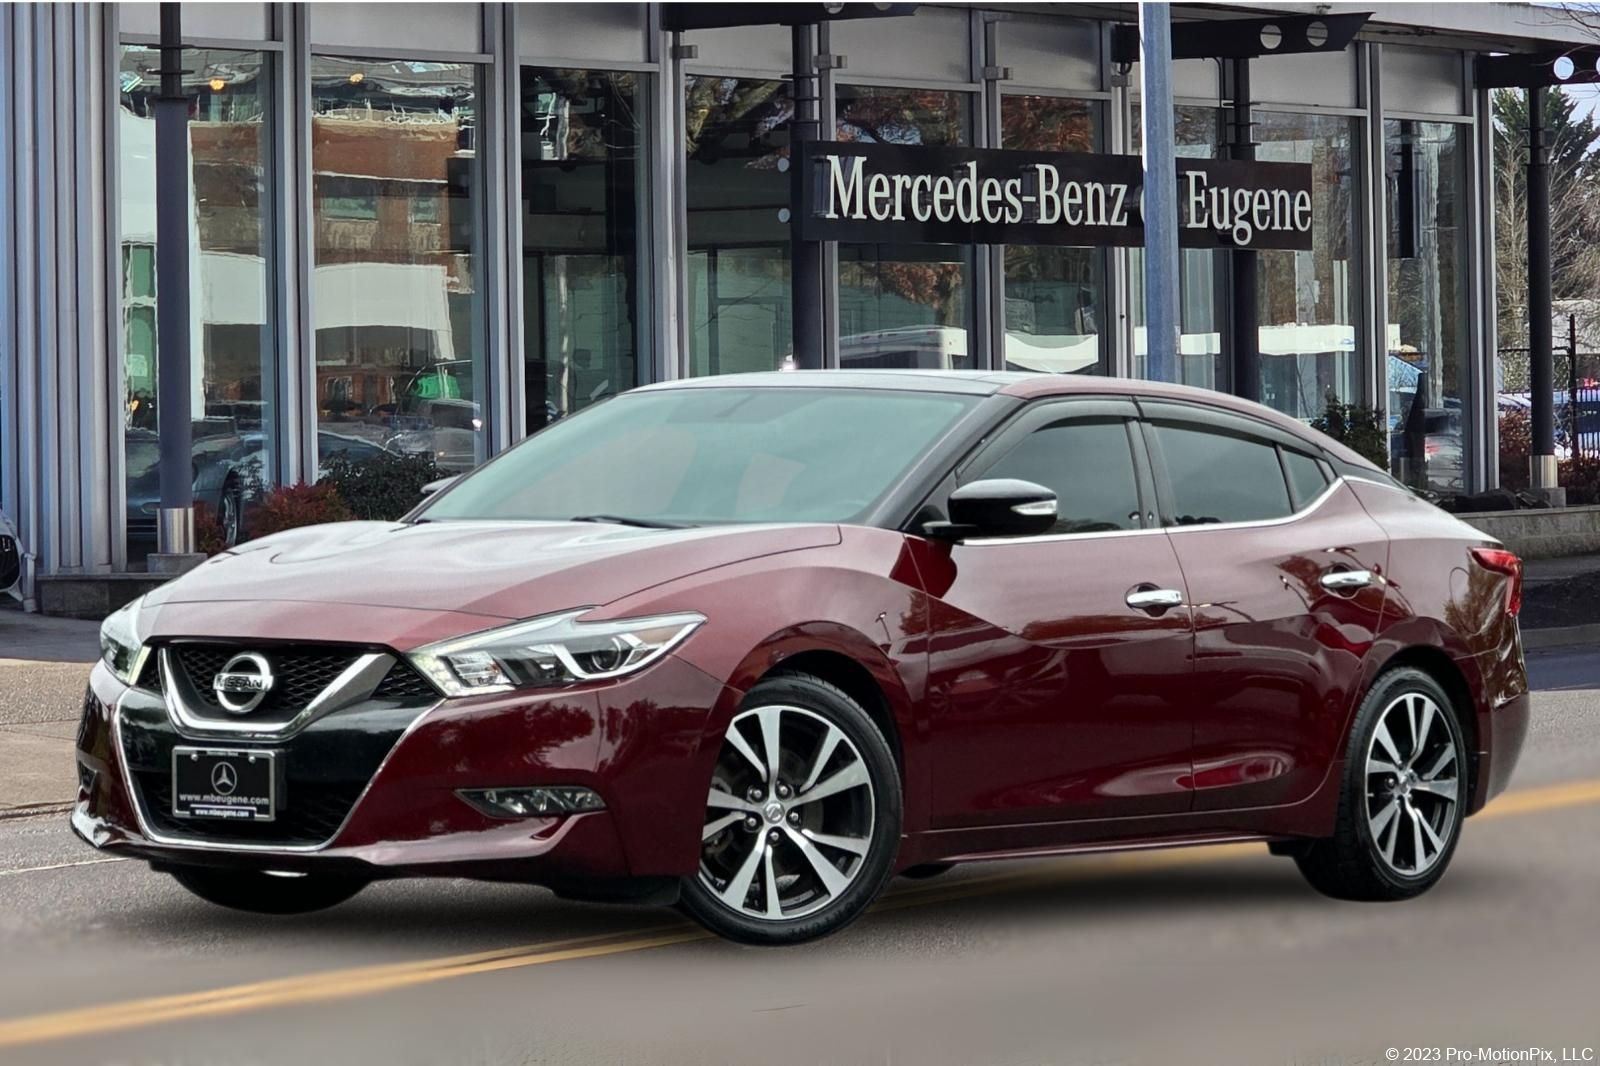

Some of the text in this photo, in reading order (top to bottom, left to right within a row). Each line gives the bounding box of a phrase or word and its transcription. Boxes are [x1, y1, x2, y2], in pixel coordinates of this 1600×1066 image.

[826, 155, 1128, 227] Mercedes-Benz
[1186, 170, 1312, 246] Eugene
[216, 676, 264, 689] NISSAN
[179, 793, 270, 805] www.mbeugene.com
